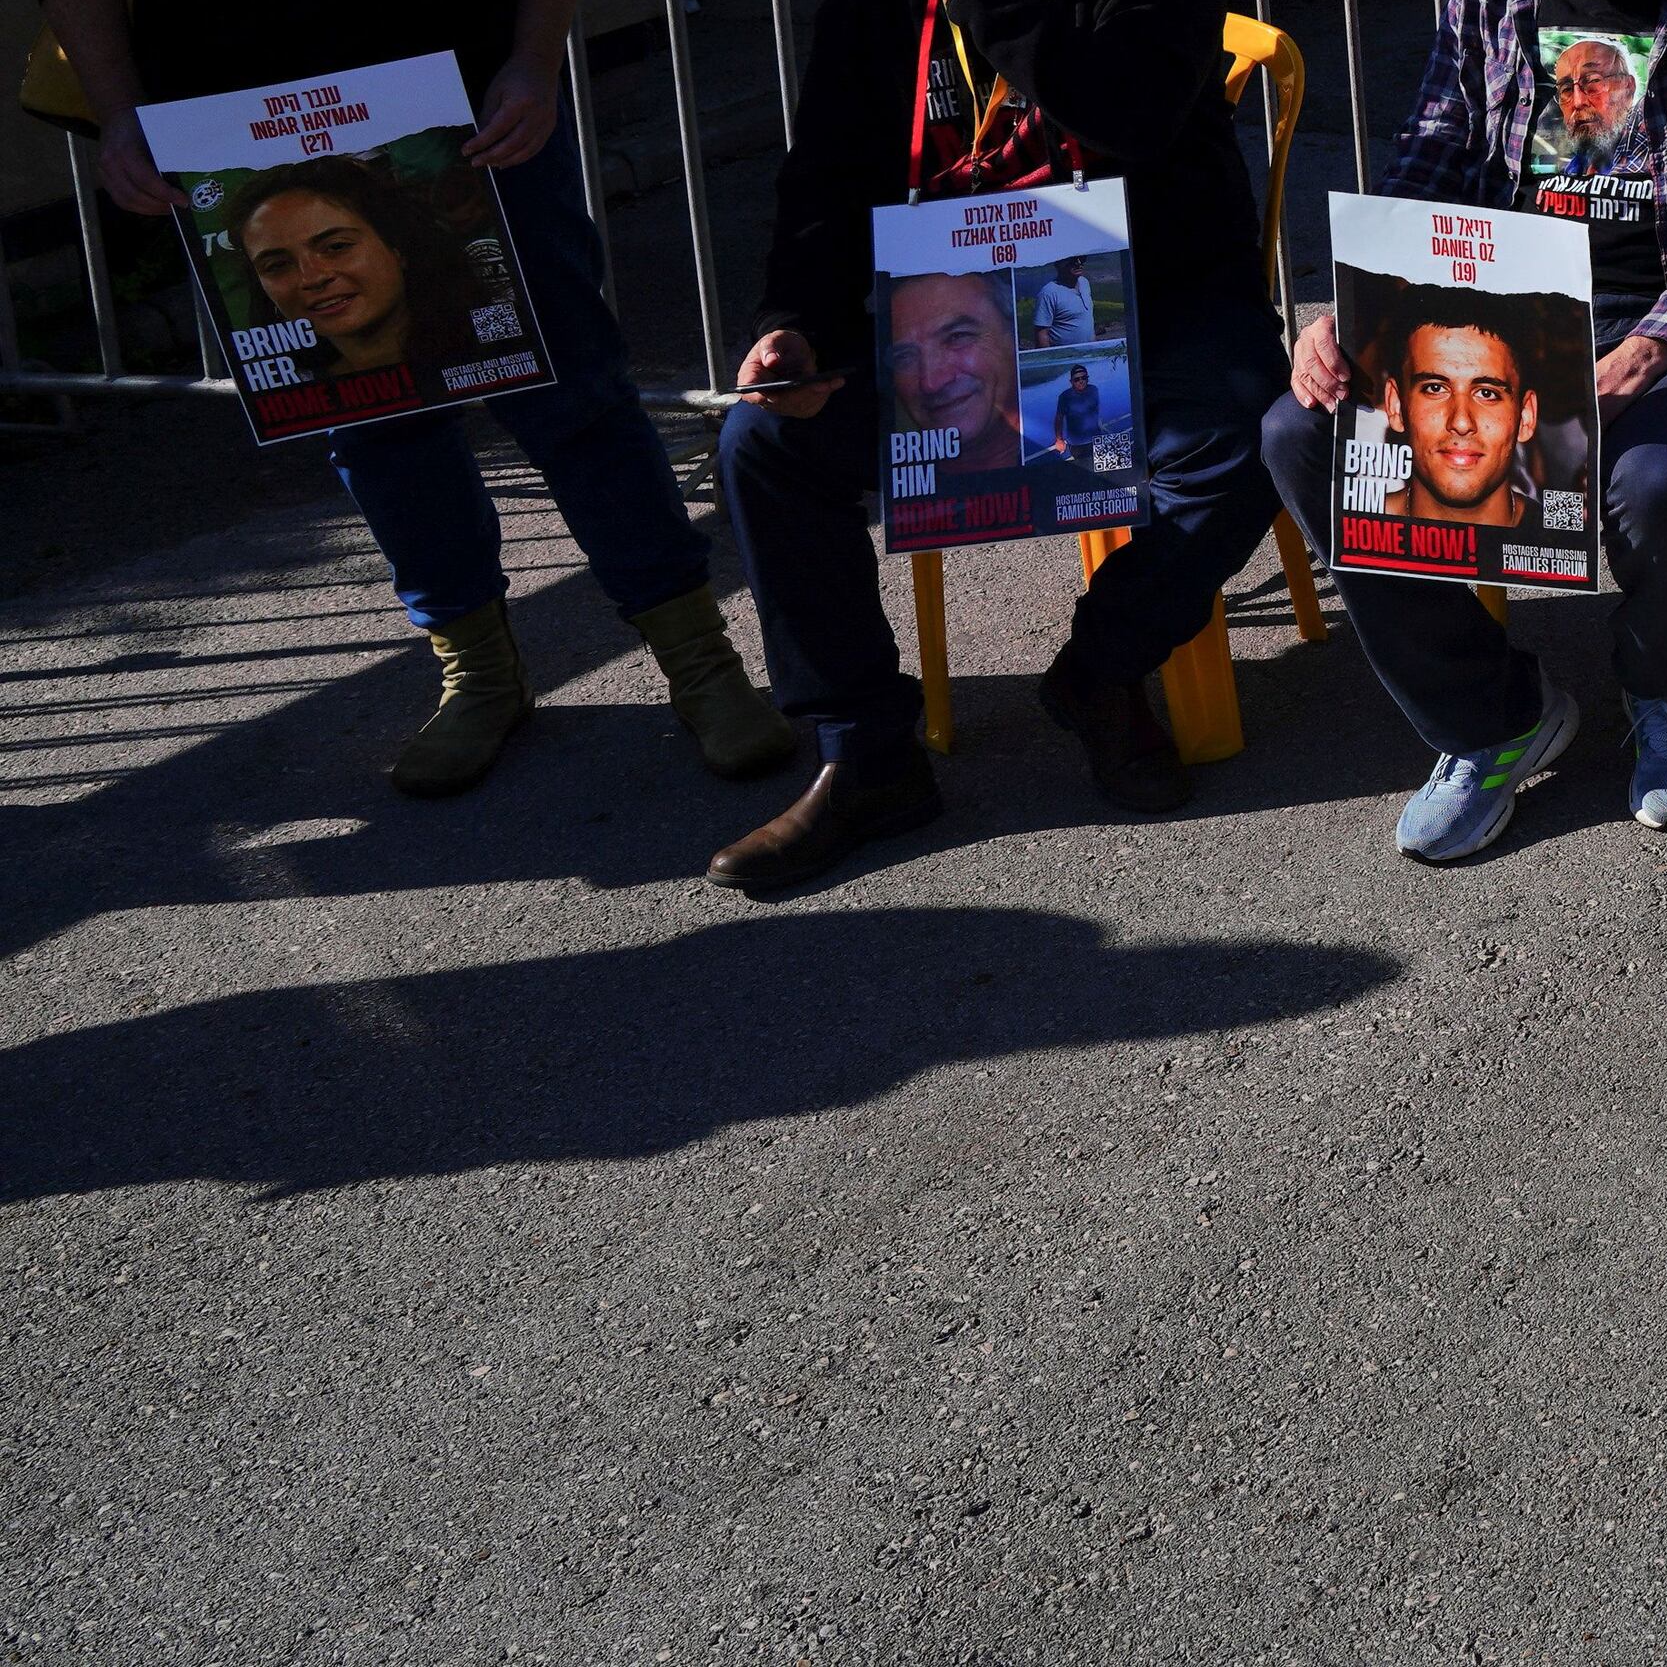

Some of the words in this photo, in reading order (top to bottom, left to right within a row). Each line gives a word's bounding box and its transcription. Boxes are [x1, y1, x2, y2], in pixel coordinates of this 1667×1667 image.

[263, 90, 302, 117] הימן
[301, 85, 342, 109] ענבר
[249, 117, 301, 142] INBAR
[300, 103, 370, 132] HAYMAN
[301, 132, 335, 156] (27)
[1590, 174, 1654, 200] מחזירים
[964, 203, 1004, 226] אלגרט
[1010, 199, 1038, 222] יצחק
[1590, 197, 1640, 222] הביתה
[951, 223, 997, 248] ITZHAK
[999, 218, 1053, 243] ELGARAT
[1432, 214, 1455, 238] עוז
[1457, 216, 1492, 240] דניאל
[991, 244, 1018, 266] (68)
[1431, 239, 1475, 261] DANIEL
[1479, 243, 1496, 263] OZ
[1452, 261, 1477, 284] (19)
[231, 318, 318, 362] BRING
[243, 356, 301, 393] HER
[441, 360, 483, 379] HOSTAGES
[482, 357, 500, 370] AND
[499, 350, 535, 366] MISSING
[445, 368, 498, 392] FAMILIES
[497, 359, 540, 380] FORUM
[256, 383, 337, 426] HOME
[336, 363, 417, 409] NOW!
[890, 426, 961, 464] BRING
[1344, 439, 1414, 481] BRING
[892, 463, 936, 499] HIM
[1055, 492, 1091, 507] HOSTAGES
[1091, 490, 1106, 502] AND
[1106, 485, 1137, 501] MISSING
[1056, 501, 1102, 521] FAMILIES
[1103, 496, 1138, 514] FORUM
[1342, 477, 1387, 516] HIM
[892, 497, 960, 536] HOME
[964, 485, 1033, 527] NOW!
[1341, 516, 1406, 556] HOME
[1409, 524, 1478, 563] NOW!
[1502, 543, 1539, 558] HOSTAGES
[1539, 546, 1554, 559] AND
[1555, 547, 1587, 561] MISSING
[1502, 554, 1549, 575] FAMILIES
[1550, 558, 1587, 578] FORUM
